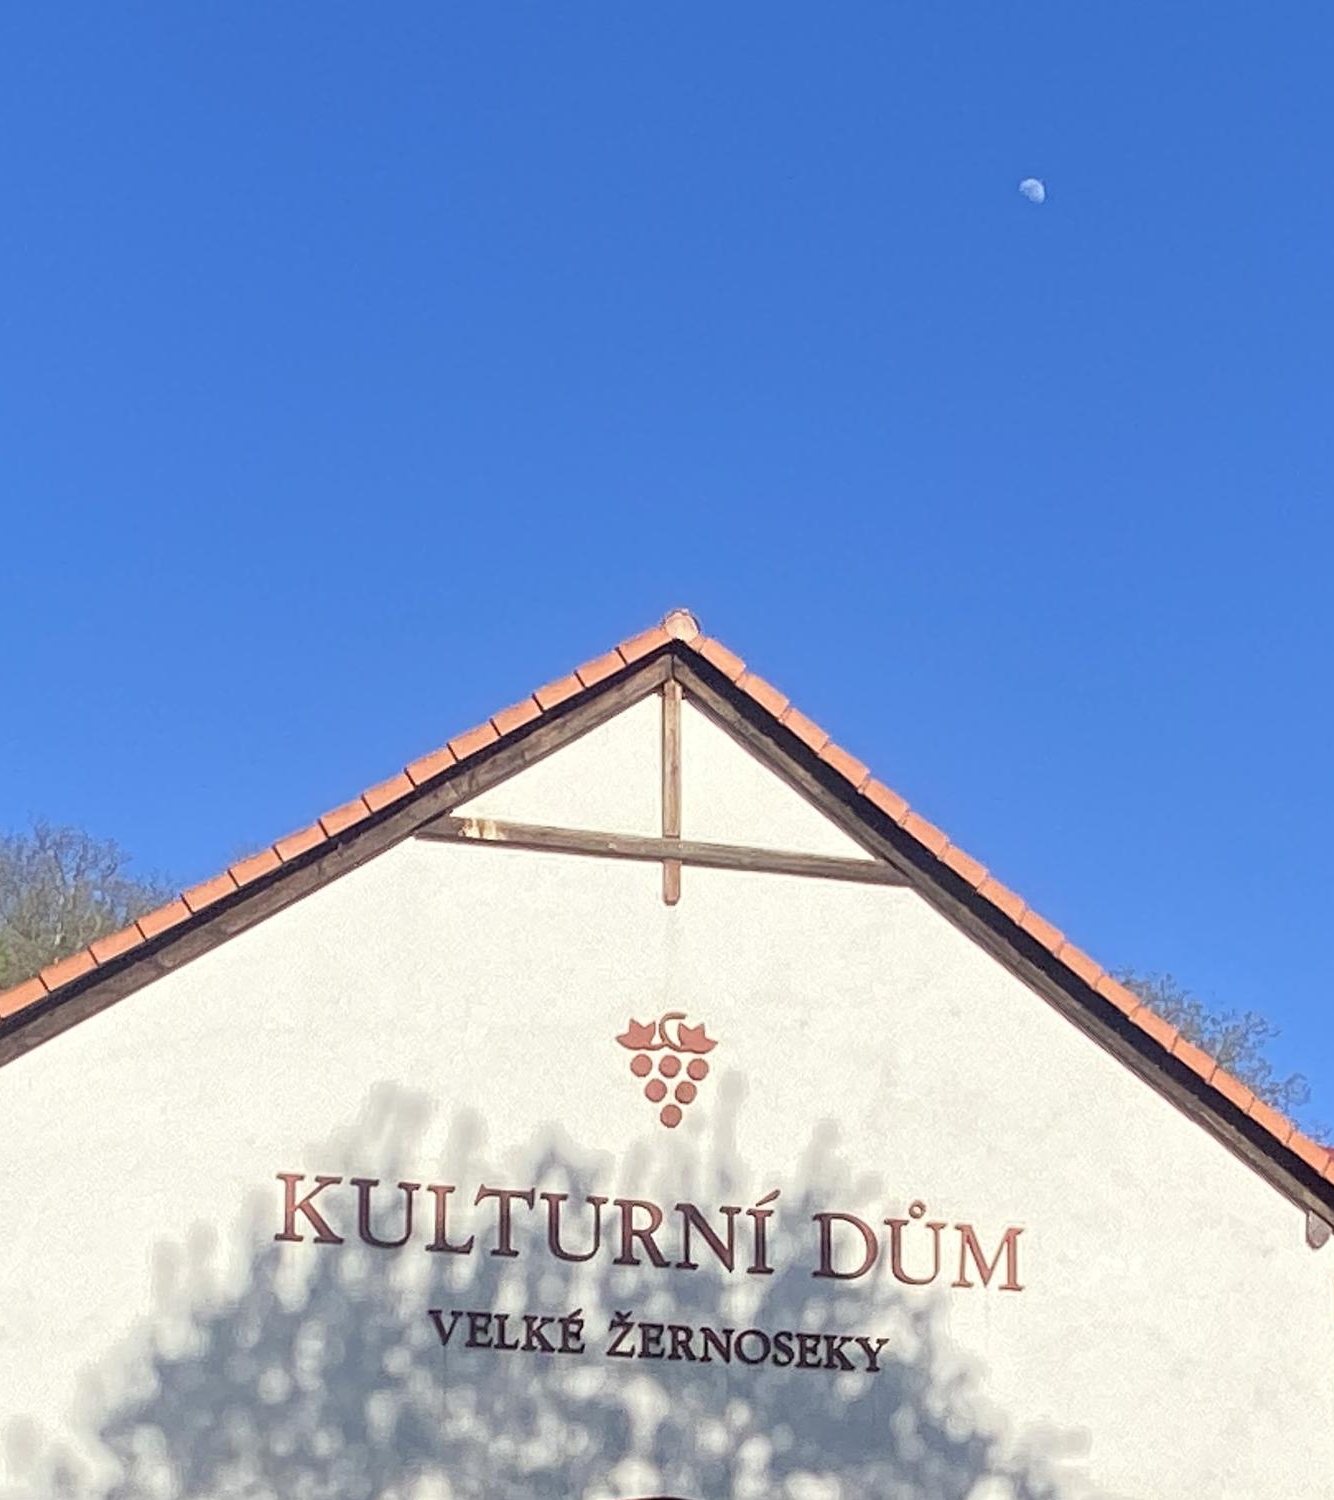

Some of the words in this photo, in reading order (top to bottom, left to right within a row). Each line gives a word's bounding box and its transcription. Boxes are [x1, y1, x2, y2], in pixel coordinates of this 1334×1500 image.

[273, 1172, 781, 1276] KULTURNÍ
[811, 1199, 1025, 1292] DŮM
[427, 1307, 586, 1355] VELKÉ
[605, 1309, 890, 1373] ŽERNOSEKY
